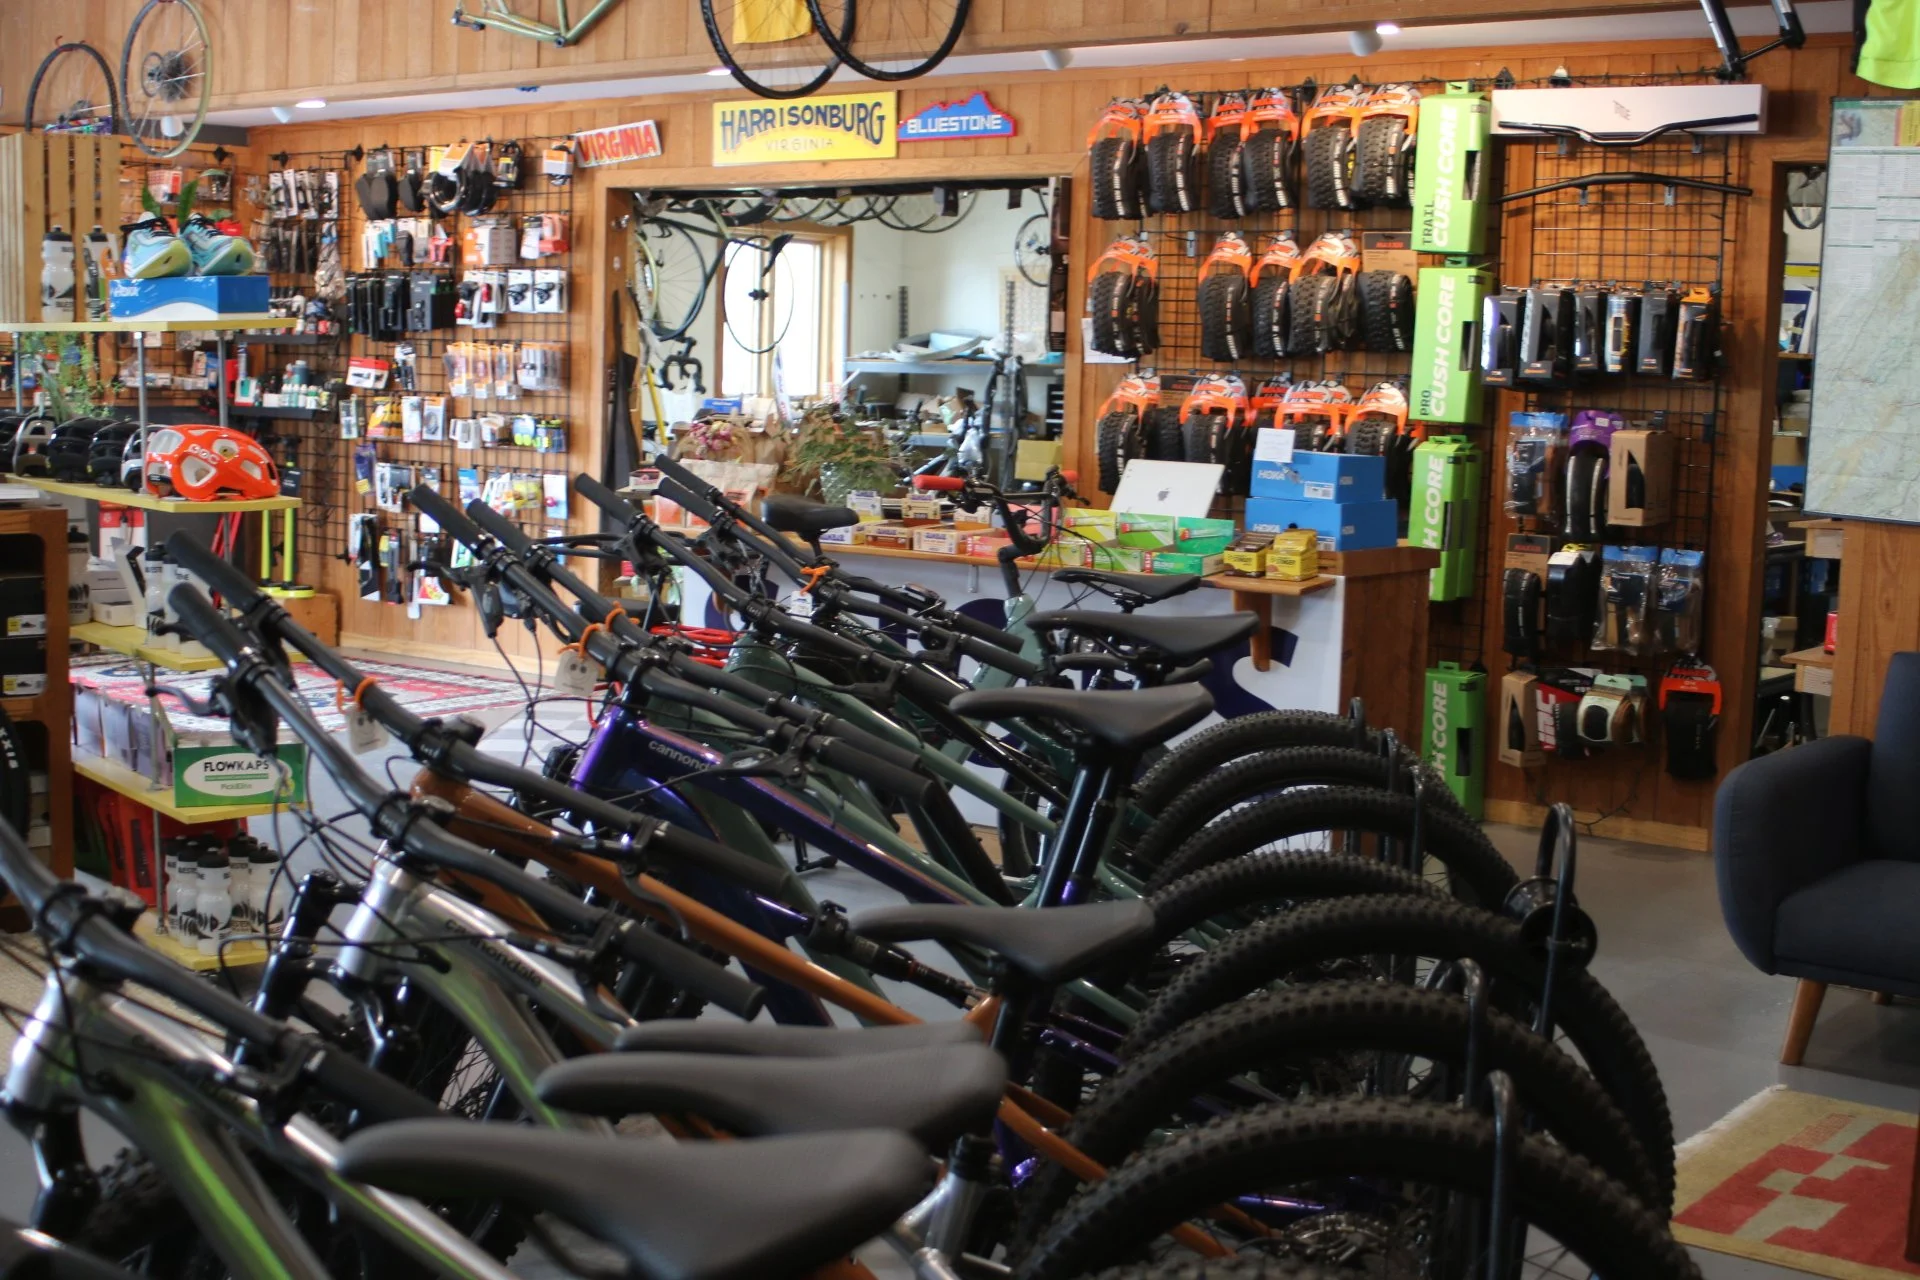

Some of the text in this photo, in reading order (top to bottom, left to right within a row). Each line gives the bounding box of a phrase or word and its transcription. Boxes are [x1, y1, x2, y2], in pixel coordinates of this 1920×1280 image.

[577, 122, 658, 164] VIRGINIA
[720, 101, 886, 155] HARRISONBURG
[906, 114, 1003, 133] BLUESTONE
[765, 138, 835, 153] VIRGINIA
[1433, 104, 1459, 247] CUSH CORE
[1423, 201, 1435, 246] TRAIL
[1430, 275, 1455, 417] CUSH CORE
[1420, 390, 1431, 416] PRO
[1424, 454, 1444, 525] CORE
[1432, 680, 1448, 748] CORE
[203, 760, 270, 773] FLOWKAPS
[648, 740, 710, 772] cannond
